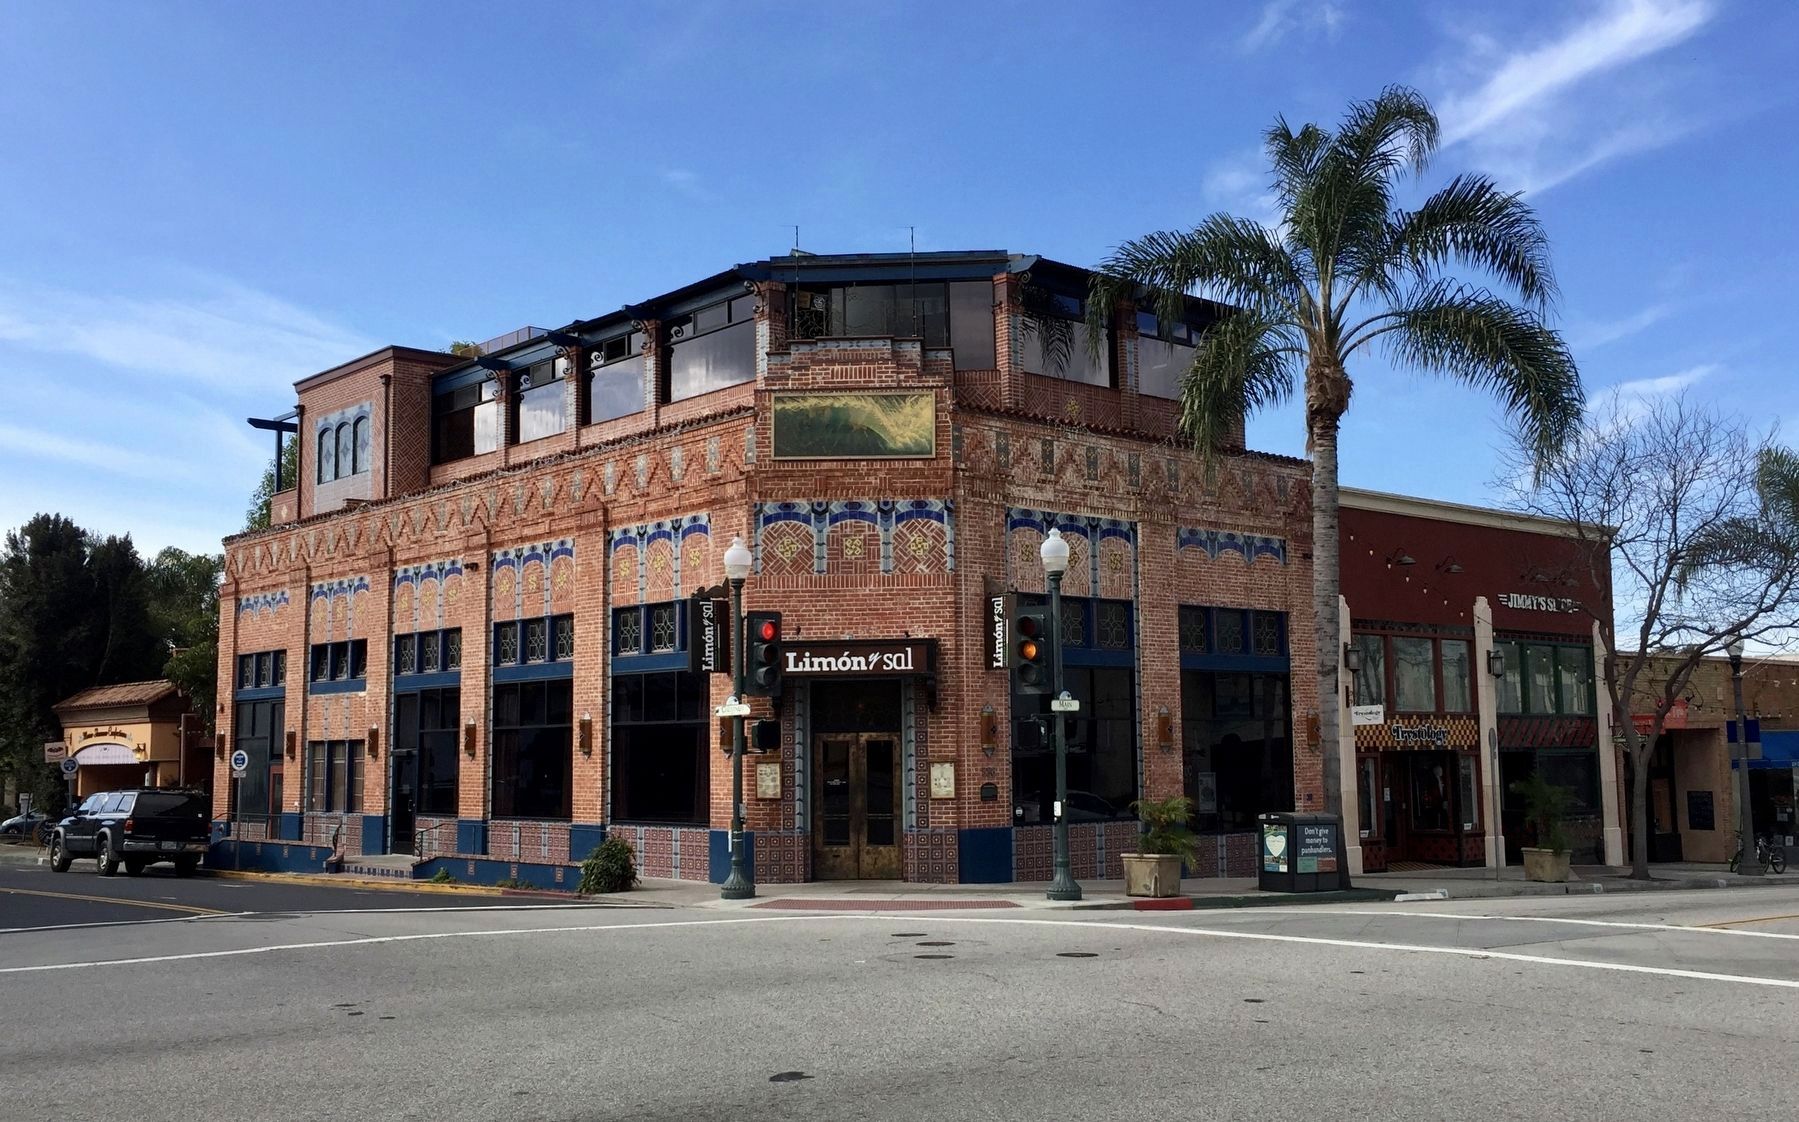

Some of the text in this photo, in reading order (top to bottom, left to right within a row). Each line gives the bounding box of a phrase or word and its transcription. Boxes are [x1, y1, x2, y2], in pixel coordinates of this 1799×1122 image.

[700, 601, 714, 618] sal
[991, 596, 1004, 614] sal
[702, 626, 714, 671] Limón
[993, 622, 1004, 668] Limón
[785, 647, 914, 672] Limón y sal
[1391, 723, 1448, 746] Trystology
[1305, 827, 1329, 837] Don't give
